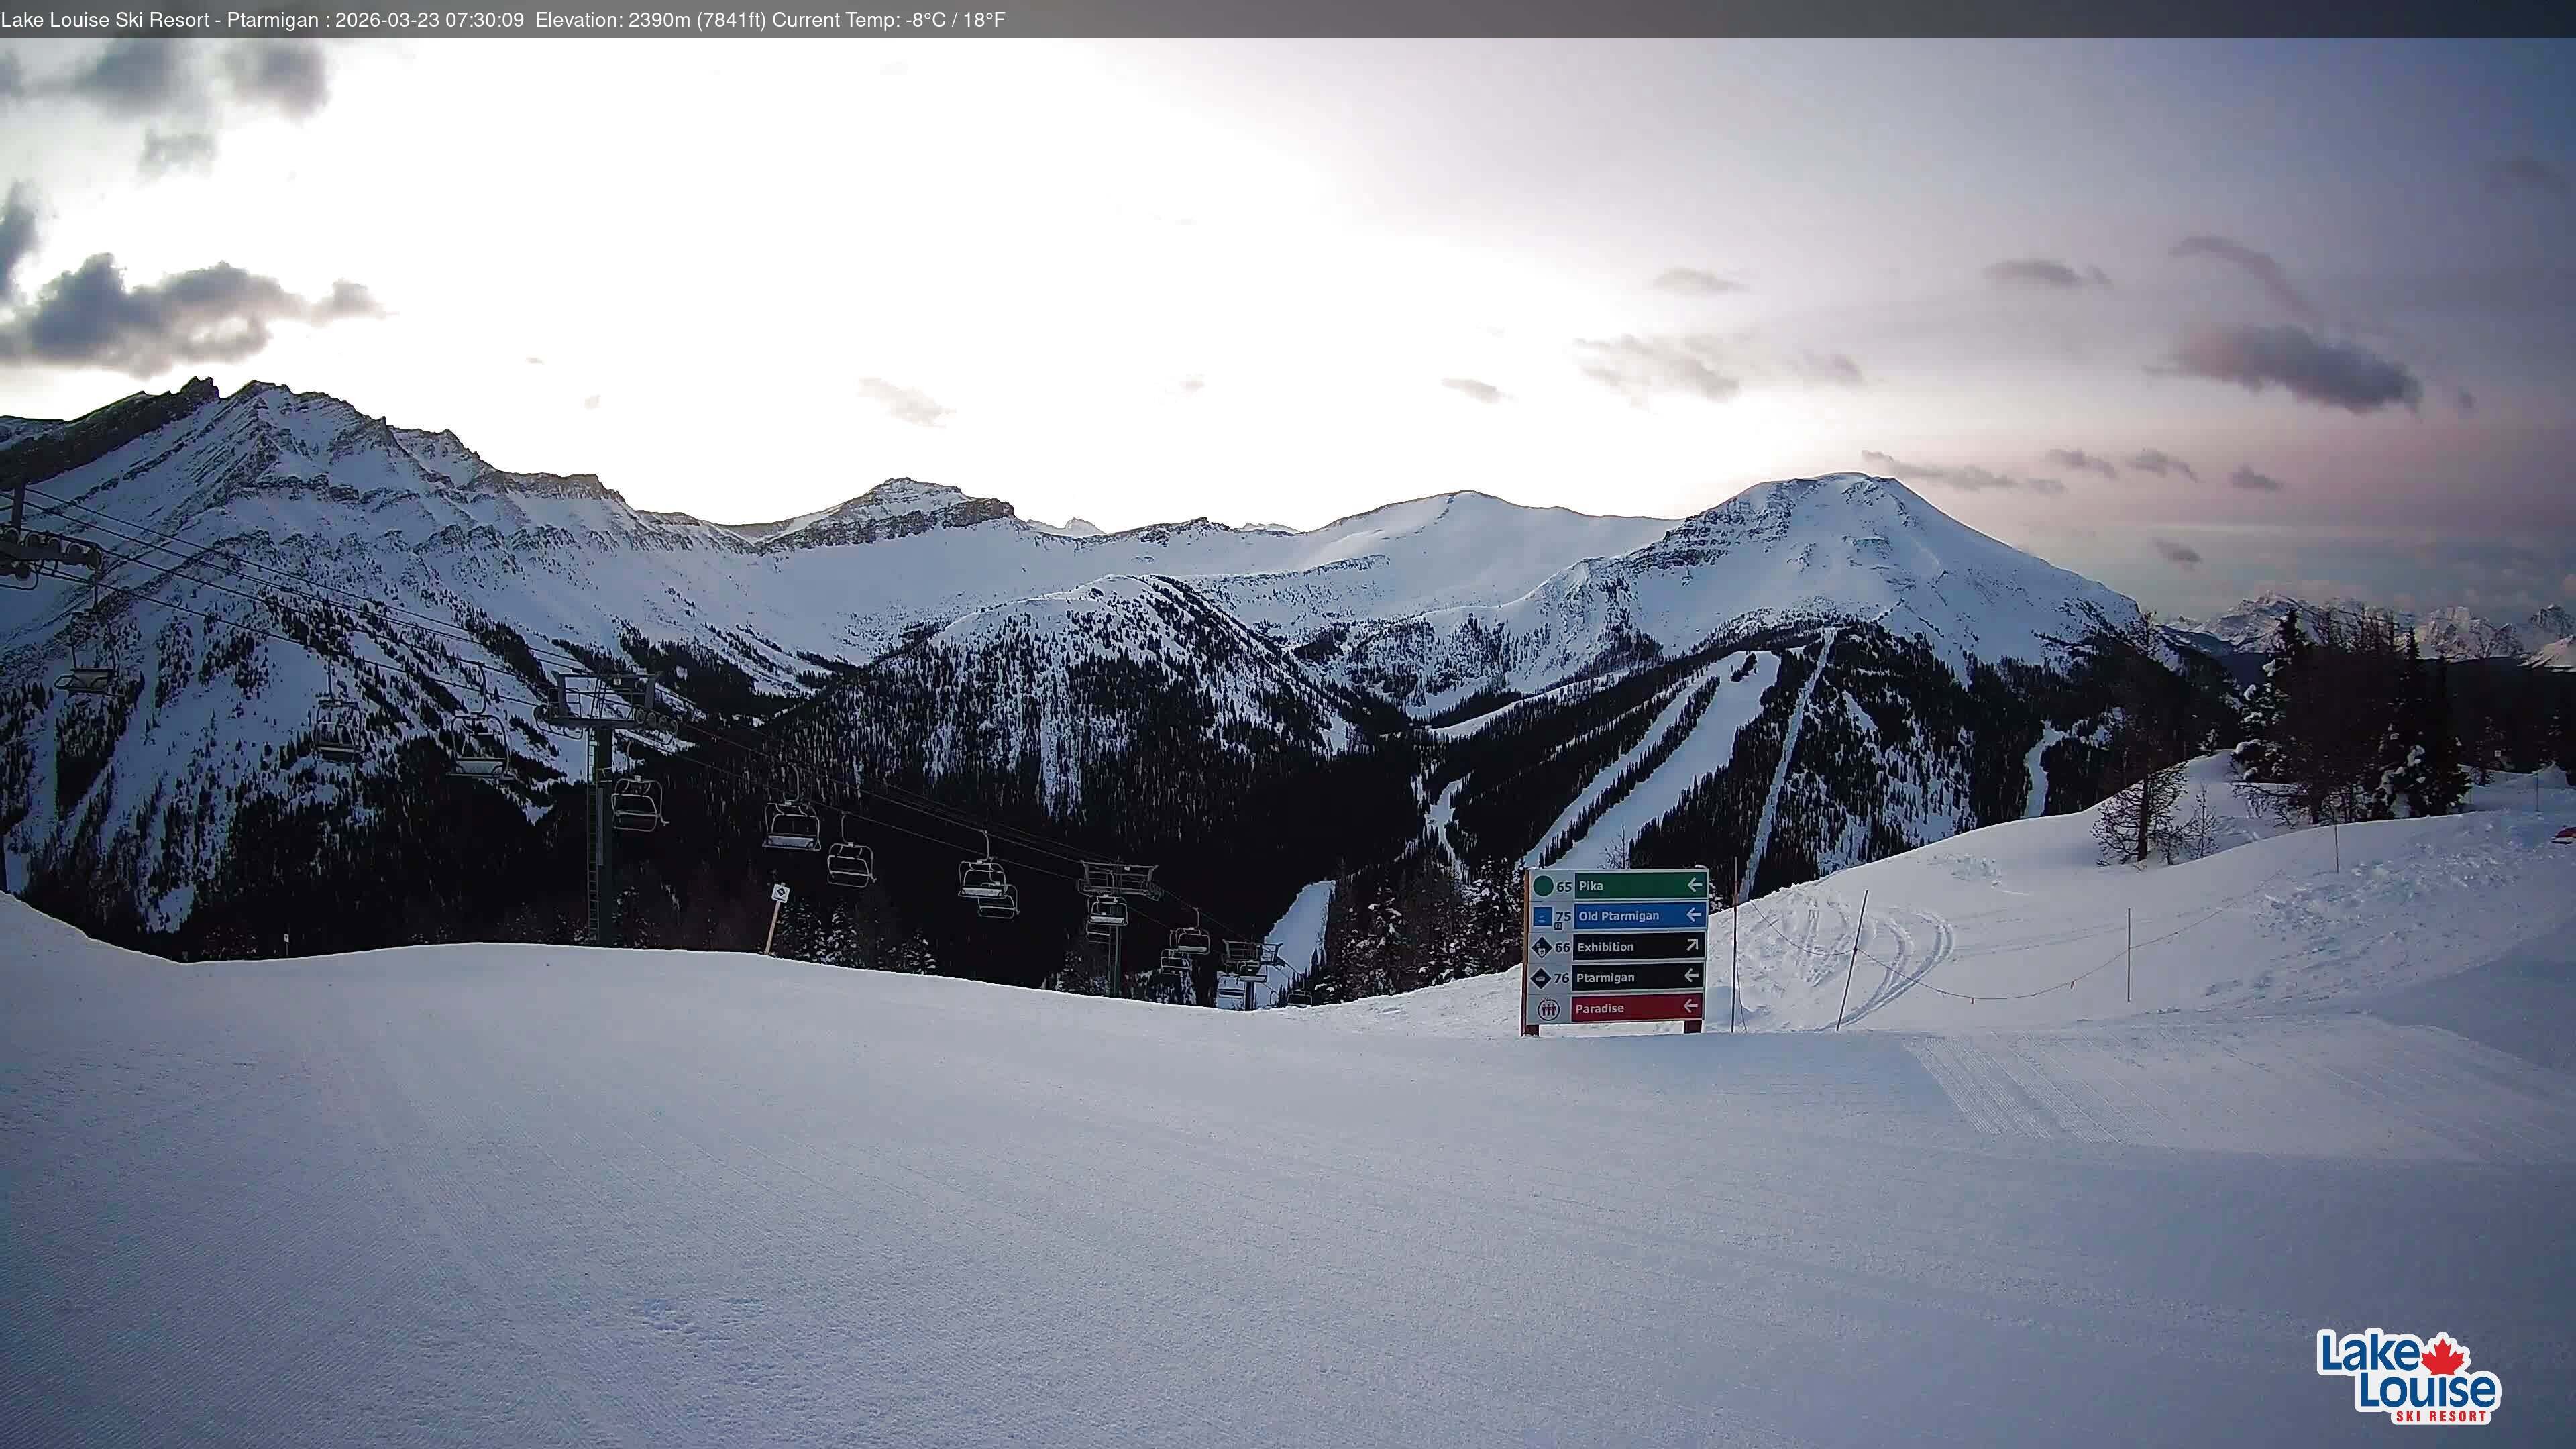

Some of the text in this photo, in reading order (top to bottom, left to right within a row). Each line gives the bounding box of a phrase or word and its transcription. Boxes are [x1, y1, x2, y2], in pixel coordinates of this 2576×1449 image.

[1556, 880, 1604, 892] 65 Pika
[1556, 911, 1660, 923] 75 Old Ptarmigan
[1555, 942, 1635, 953] 66 Exhibition
[1554, 973, 1635, 985] 76 Ptarmigan
[1576, 1004, 1625, 1014] Paradise
